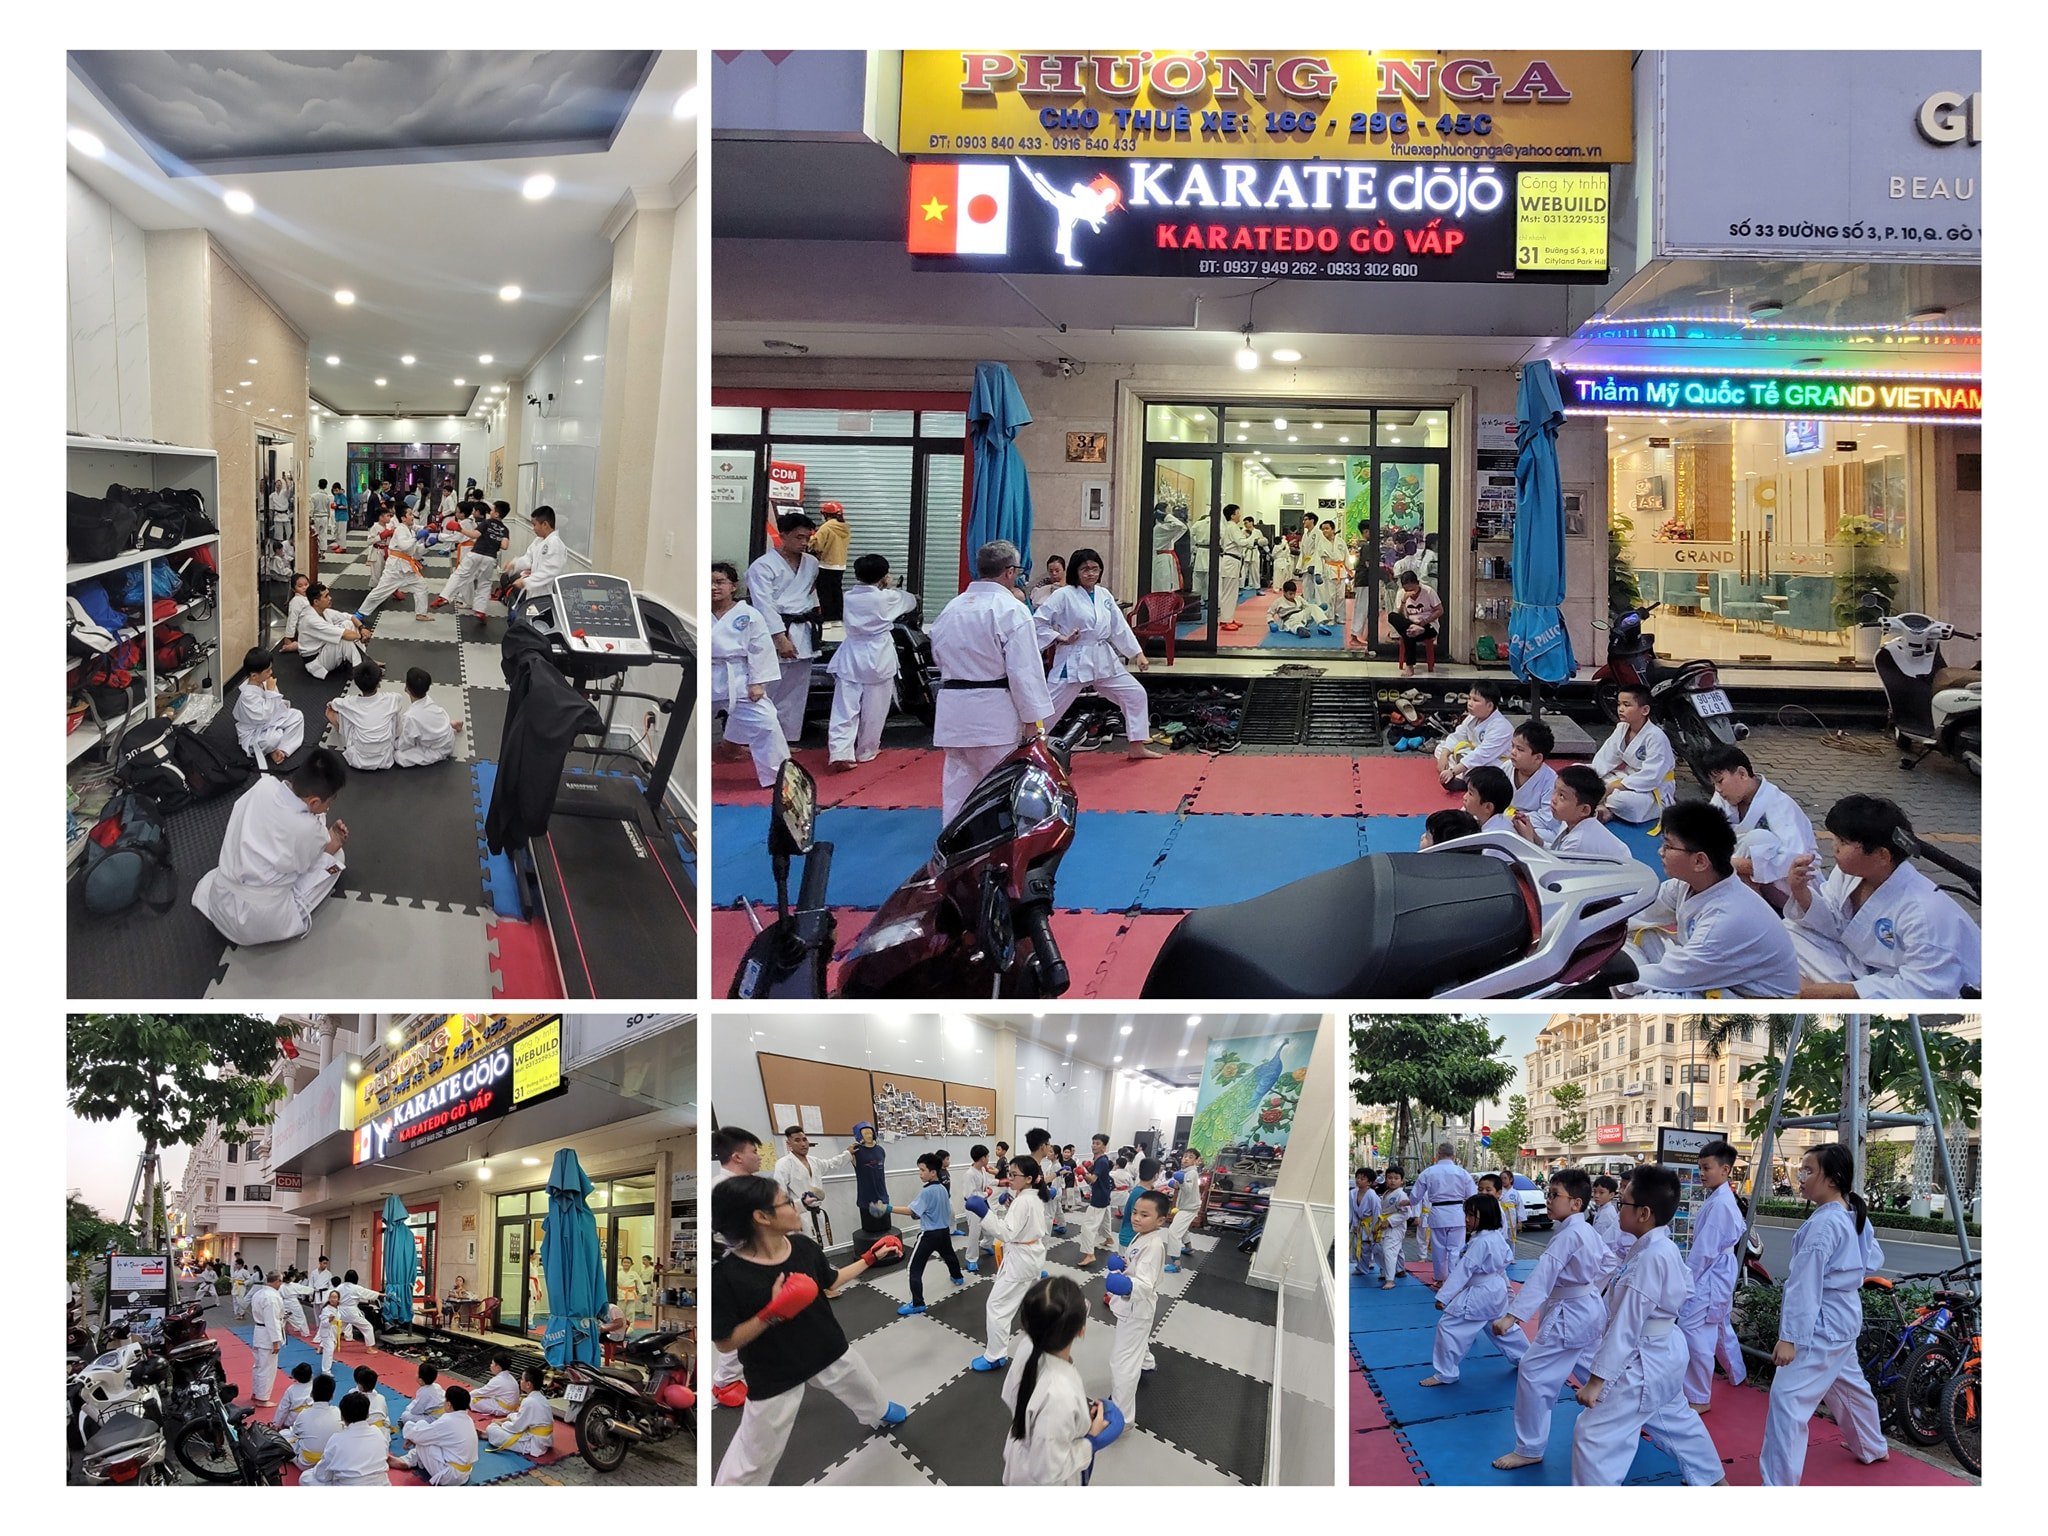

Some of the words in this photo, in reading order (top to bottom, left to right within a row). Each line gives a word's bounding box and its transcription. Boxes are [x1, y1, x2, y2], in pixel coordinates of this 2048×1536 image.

[960, 51, 1337, 98] PHƯƠNG
[1377, 59, 1572, 100] NGA
[1039, 107, 1101, 130] CHO
[1114, 105, 1190, 131] THUÊ
[1200, 111, 1249, 132] XE:
[1265, 111, 1317, 133] 16C
[1350, 112, 1407, 134] 29C
[1436, 113, 1493, 135] 45C
[956, 135, 987, 149] 0903
[991, 136, 1014, 149] 840
[1018, 137, 1041, 150] 433
[1052, 138, 1080, 151] 0916
[1113, 139, 1136, 151] 433
[1128, 162, 1377, 209] KARATE
[1521, 176, 1557, 193] Công
[1563, 178, 1574, 193] ty
[1579, 176, 1606, 190] tnhh
[1520, 196, 1607, 212] WEBUILD
[1520, 215, 1541, 223] Mst:
[1543, 215, 1606, 223] 0313229535
[1156, 224, 1340, 252] KARATEDO
[1350, 219, 1395, 253] GÒ
[1404, 218, 1465, 254] VẤP
[1729, 218, 1751, 237] SỐ
[1755, 224, 1774, 237] 33
[1778, 220, 1838, 238] ĐƯỜNG
[1842, 221, 1864, 239] SỐ
[1946, 223, 1972, 241] GÒ
[1519, 246, 1539, 264] 31
[1199, 260, 1220, 273] ĐT:
[1223, 260, 1258, 274] 0937
[1261, 261, 1289, 275] 949
[1292, 262, 1317, 275] 262
[1327, 262, 1360, 276] 0933
[1364, 263, 1389, 276] 302
[1392, 263, 1418, 277] 600
[1576, 376, 1639, 402] Thẩm
[1646, 381, 1680, 407] Mỹ
[1685, 379, 1746, 405] Quốc
[1750, 380, 1780, 405] Tế
[1785, 384, 1875, 407] GRAND
[1880, 386, 1982, 409] VIETNAM
[1077, 435, 1096, 448] 31
[772, 468, 797, 480] CDM
[1675, 550, 1734, 563] GRAND
[515, 1038, 559, 1067] WEBUILD
[393, 1072, 462, 1127] KARATE
[515, 1086, 525, 1100] 31
[399, 1111, 449, 1142] KARATEDO
[450, 1099, 468, 1121] GÒ
[469, 1087, 494, 1113] VẤP
[277, 1176, 301, 1187] CDM
